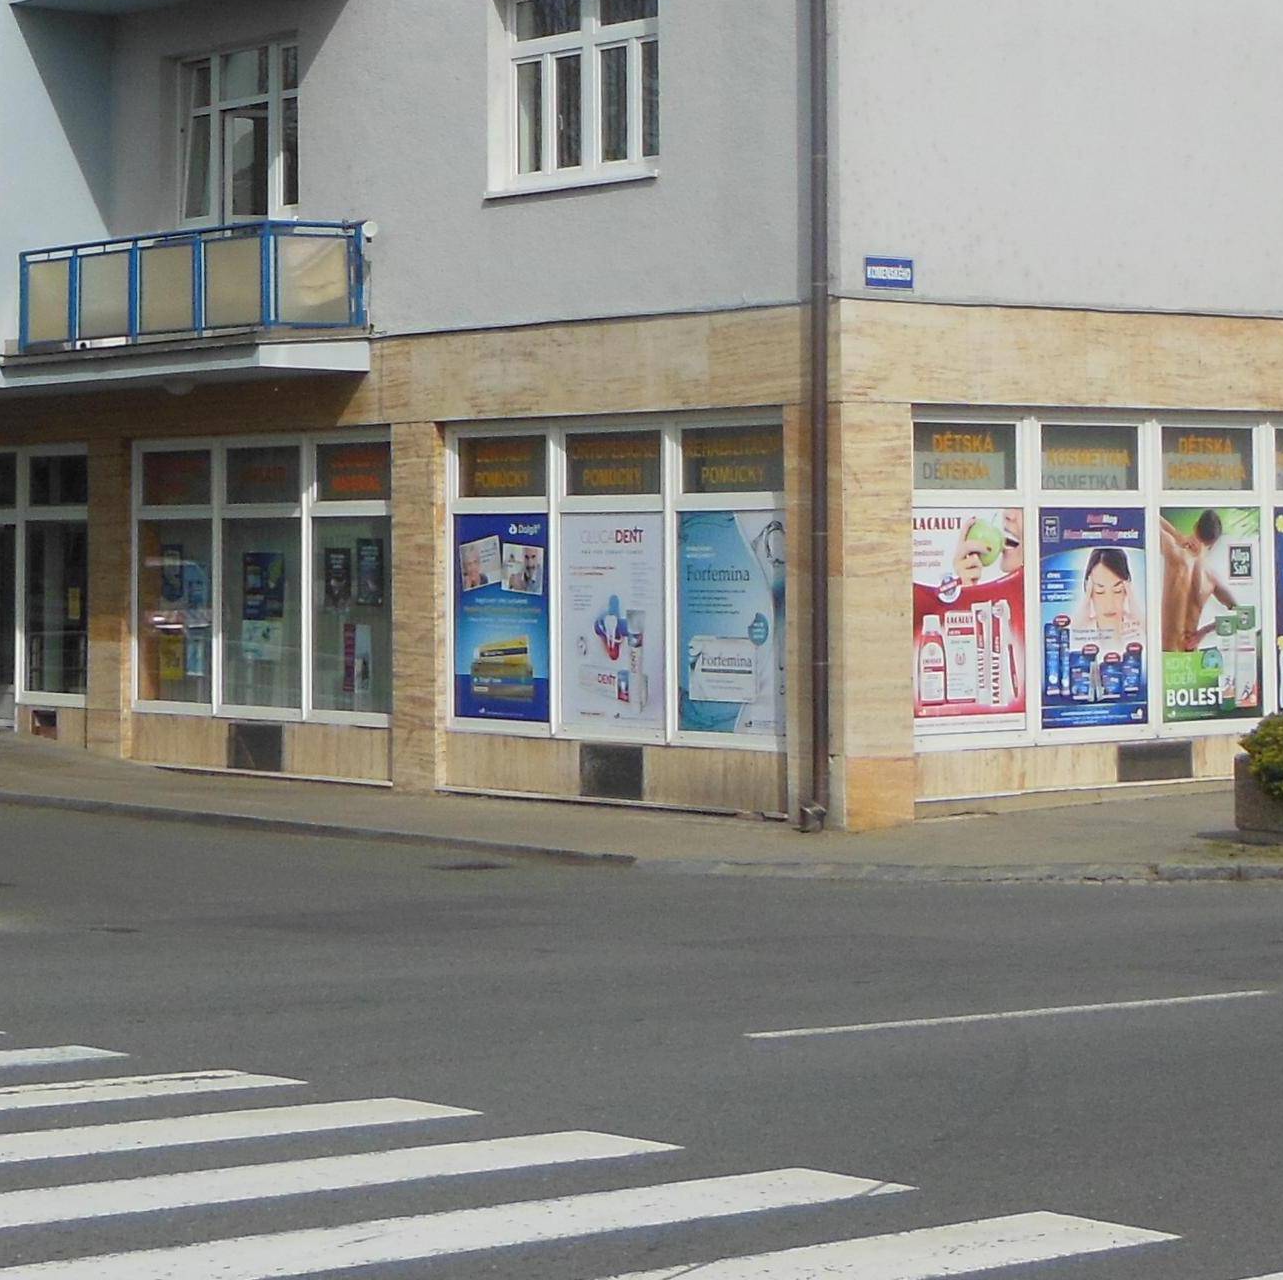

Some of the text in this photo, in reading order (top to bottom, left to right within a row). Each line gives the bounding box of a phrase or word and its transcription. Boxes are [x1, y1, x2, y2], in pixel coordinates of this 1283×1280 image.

[932, 432, 995, 453] DĚTSKÁ
[912, 517, 962, 530] LACALUT
[1166, 687, 1225, 707] BOLEST
